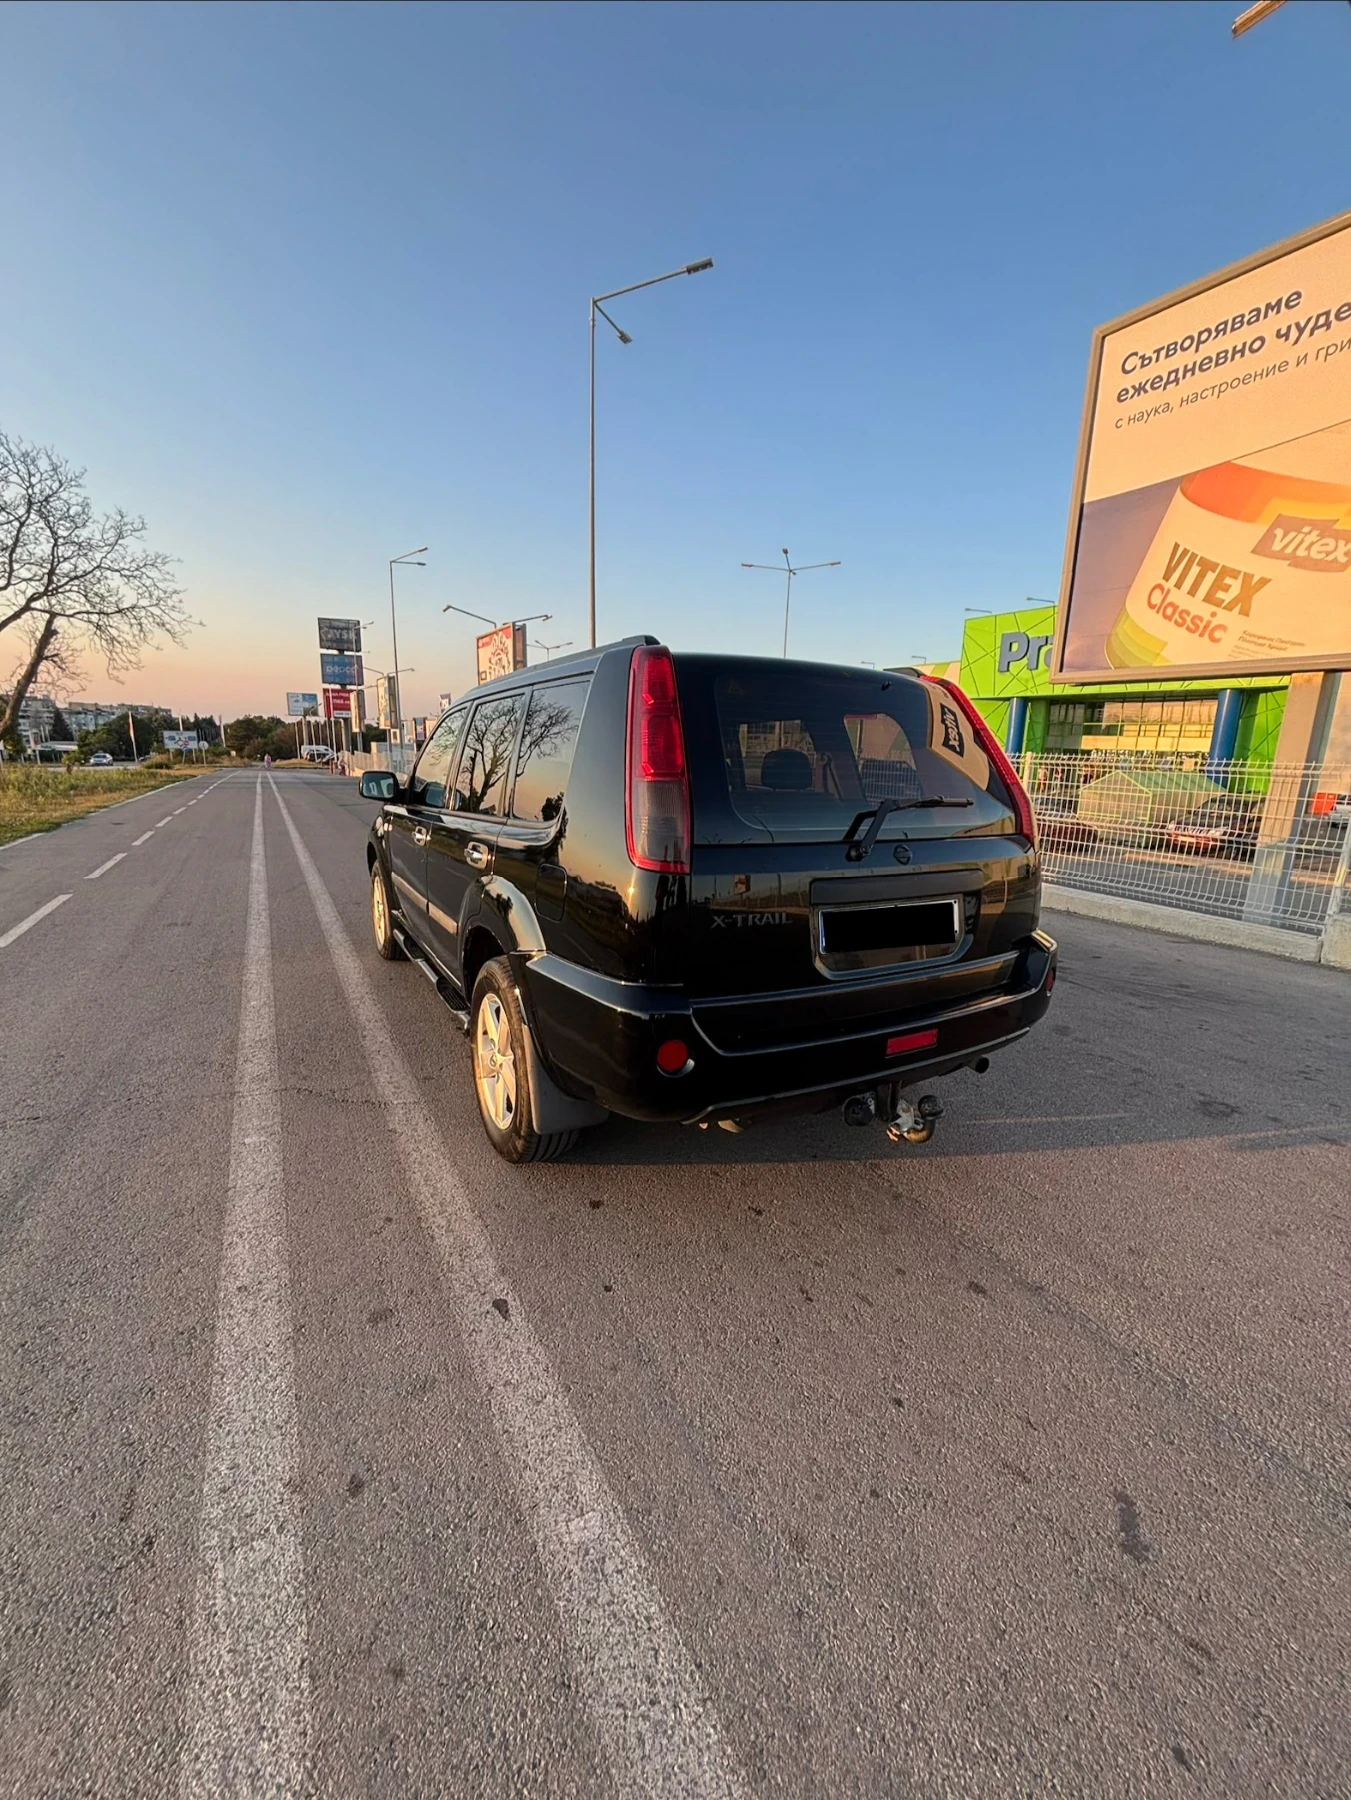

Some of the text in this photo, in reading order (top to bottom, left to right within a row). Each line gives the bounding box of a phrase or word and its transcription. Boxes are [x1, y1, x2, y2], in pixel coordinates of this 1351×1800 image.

[1116, 301, 1351, 404] ежедневно чуде
[1120, 290, 1302, 375] Сътворяваме
[1115, 417, 1124, 429] с
[1127, 401, 1174, 425] наука,
[1179, 359, 1289, 408] настроение
[1295, 352, 1308, 368] и
[1162, 541, 1273, 618] VITEX
[1271, 525, 1351, 564] vitex
[1146, 583, 1229, 644] Classic
[710, 912, 794, 929] X-TRAIL
